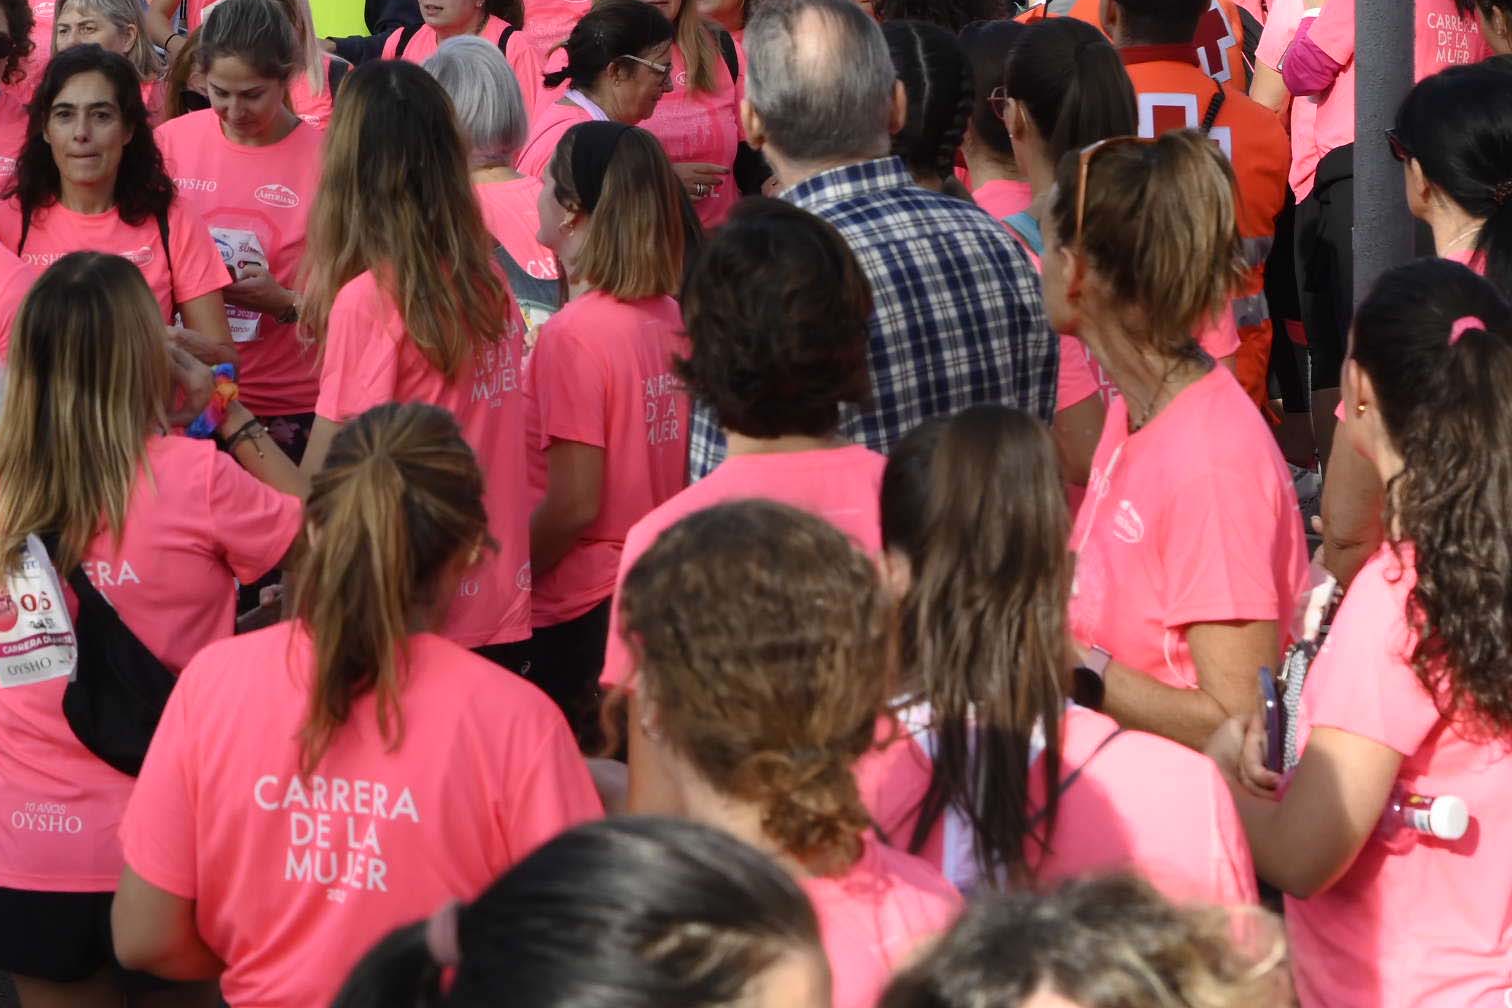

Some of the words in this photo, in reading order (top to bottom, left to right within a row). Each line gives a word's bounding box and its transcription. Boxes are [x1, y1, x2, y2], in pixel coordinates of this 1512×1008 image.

[172, 177, 217, 193] OYSHO
[2, 636, 42, 655] CARRERA
[7, 656, 52, 676] OYSHO
[35, 800, 67, 816] AÑOS
[253, 773, 421, 823] CARRERA
[11, 809, 84, 835] OYSHO
[290, 811, 331, 850] DE
[346, 816, 382, 856] LA
[284, 846, 388, 892] MUJER
